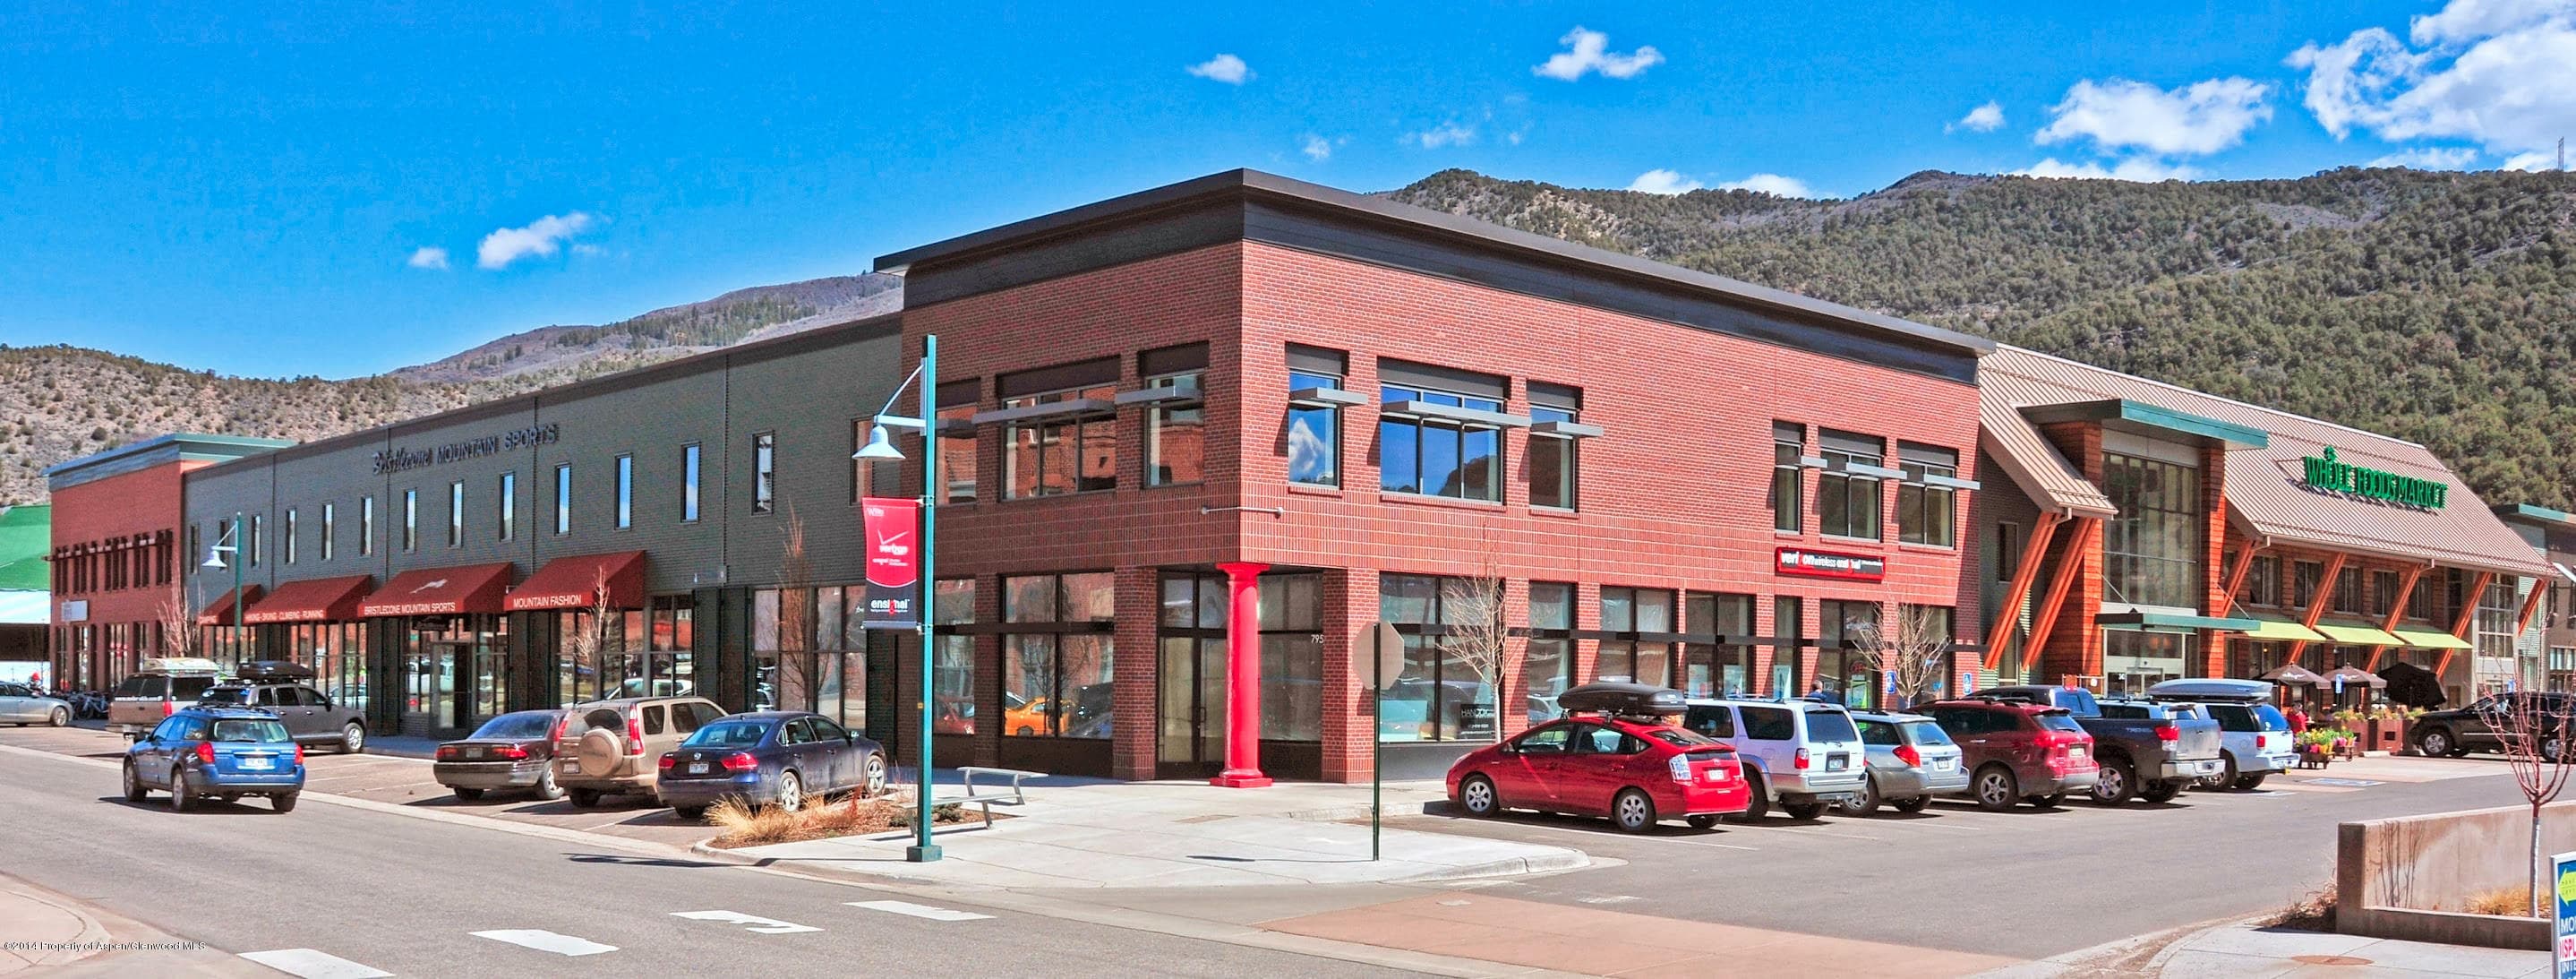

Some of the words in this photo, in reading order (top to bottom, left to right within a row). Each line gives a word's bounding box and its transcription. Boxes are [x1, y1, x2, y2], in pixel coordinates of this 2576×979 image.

[437, 436, 498, 464] MOUNTAIN
[504, 424, 559, 451] SPORTS
[2304, 455, 2355, 492] WHOLE
[2356, 466, 2399, 500] FOODS
[2398, 475, 2448, 510] MARKET
[513, 597, 549, 608] MOUNTAIN
[550, 594, 582, 606] FASHION
[364, 605, 400, 615] BRISTLECONE
[401, 603, 431, 614] MOUNTAIN
[431, 602, 456, 612] SPORTS
[1311, 634, 1324, 644] 795
